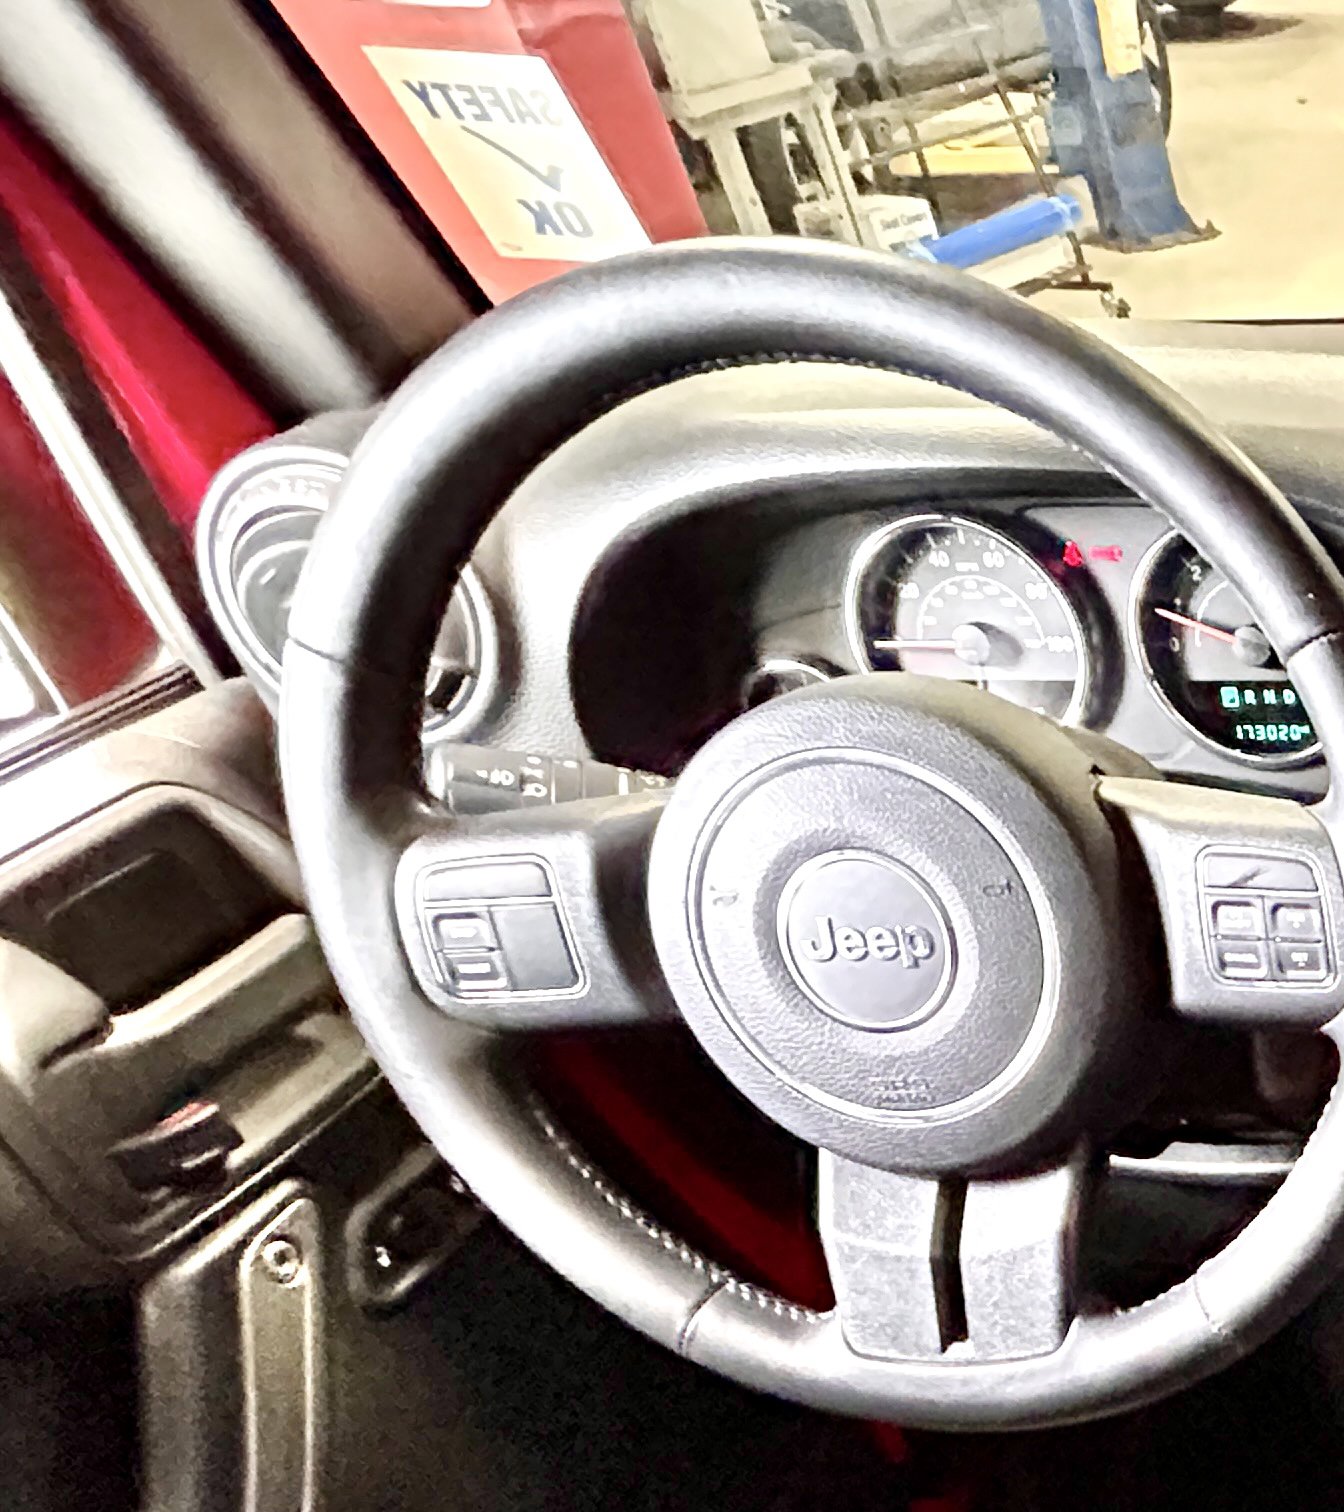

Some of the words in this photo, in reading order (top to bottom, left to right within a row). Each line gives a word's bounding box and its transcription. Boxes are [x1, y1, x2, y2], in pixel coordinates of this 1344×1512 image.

[929, 550, 950, 567] 40
[1190, 564, 1202, 581] 2
[1283, 688, 1296, 704] D
[1236, 724, 1301, 741] 173020
[800, 914, 935, 969] Jeep
